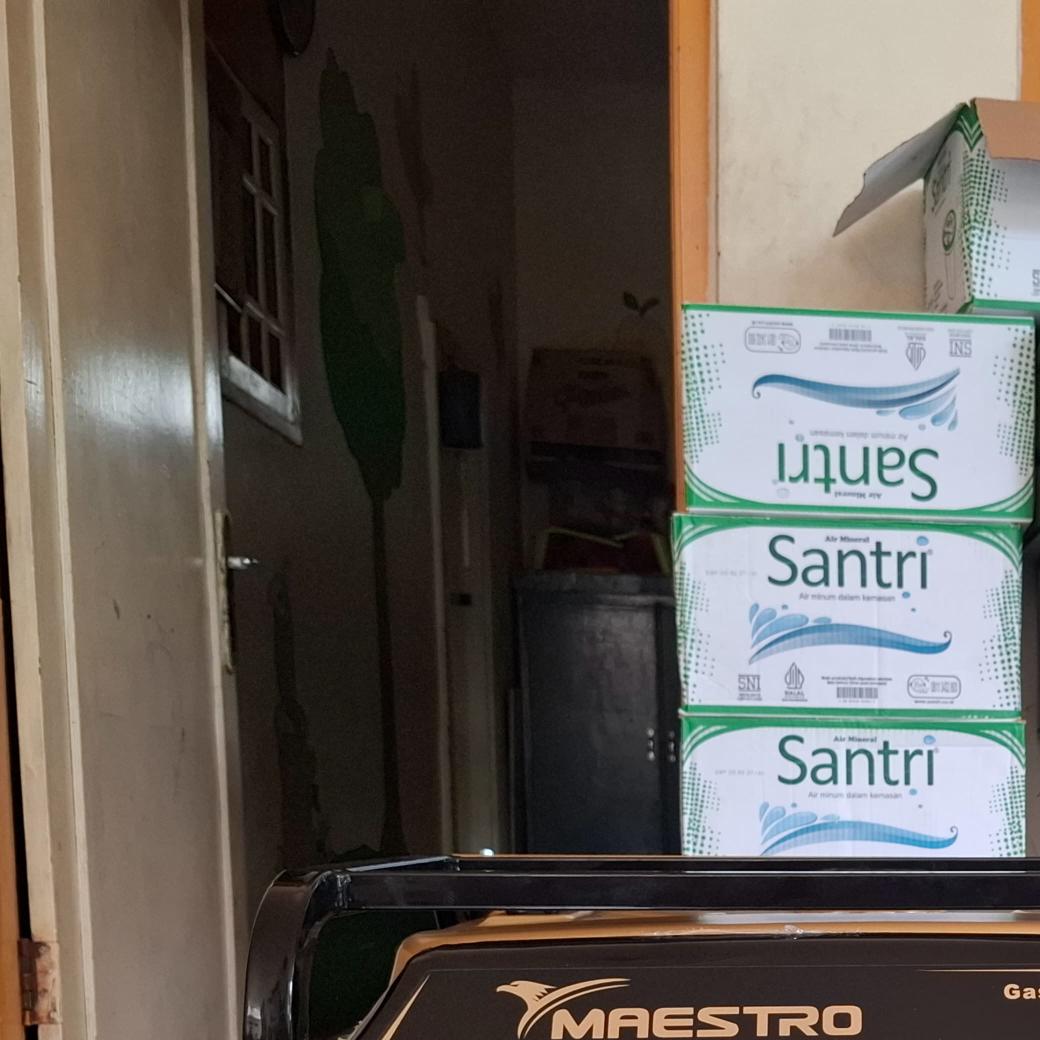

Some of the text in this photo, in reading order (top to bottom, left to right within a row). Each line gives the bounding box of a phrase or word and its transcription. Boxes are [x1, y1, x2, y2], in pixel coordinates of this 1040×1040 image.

[949, 339, 973, 357] SNI
[778, 443, 939, 502] Santri
[768, 534, 928, 589] Santri
[799, 592, 896, 602] Air minum dalam kemasan
[738, 674, 760, 692] SNI
[778, 734, 936, 786] Santri
[846, 791, 867, 799] dalam
[550, 1005, 863, 1040] MAESTRO
